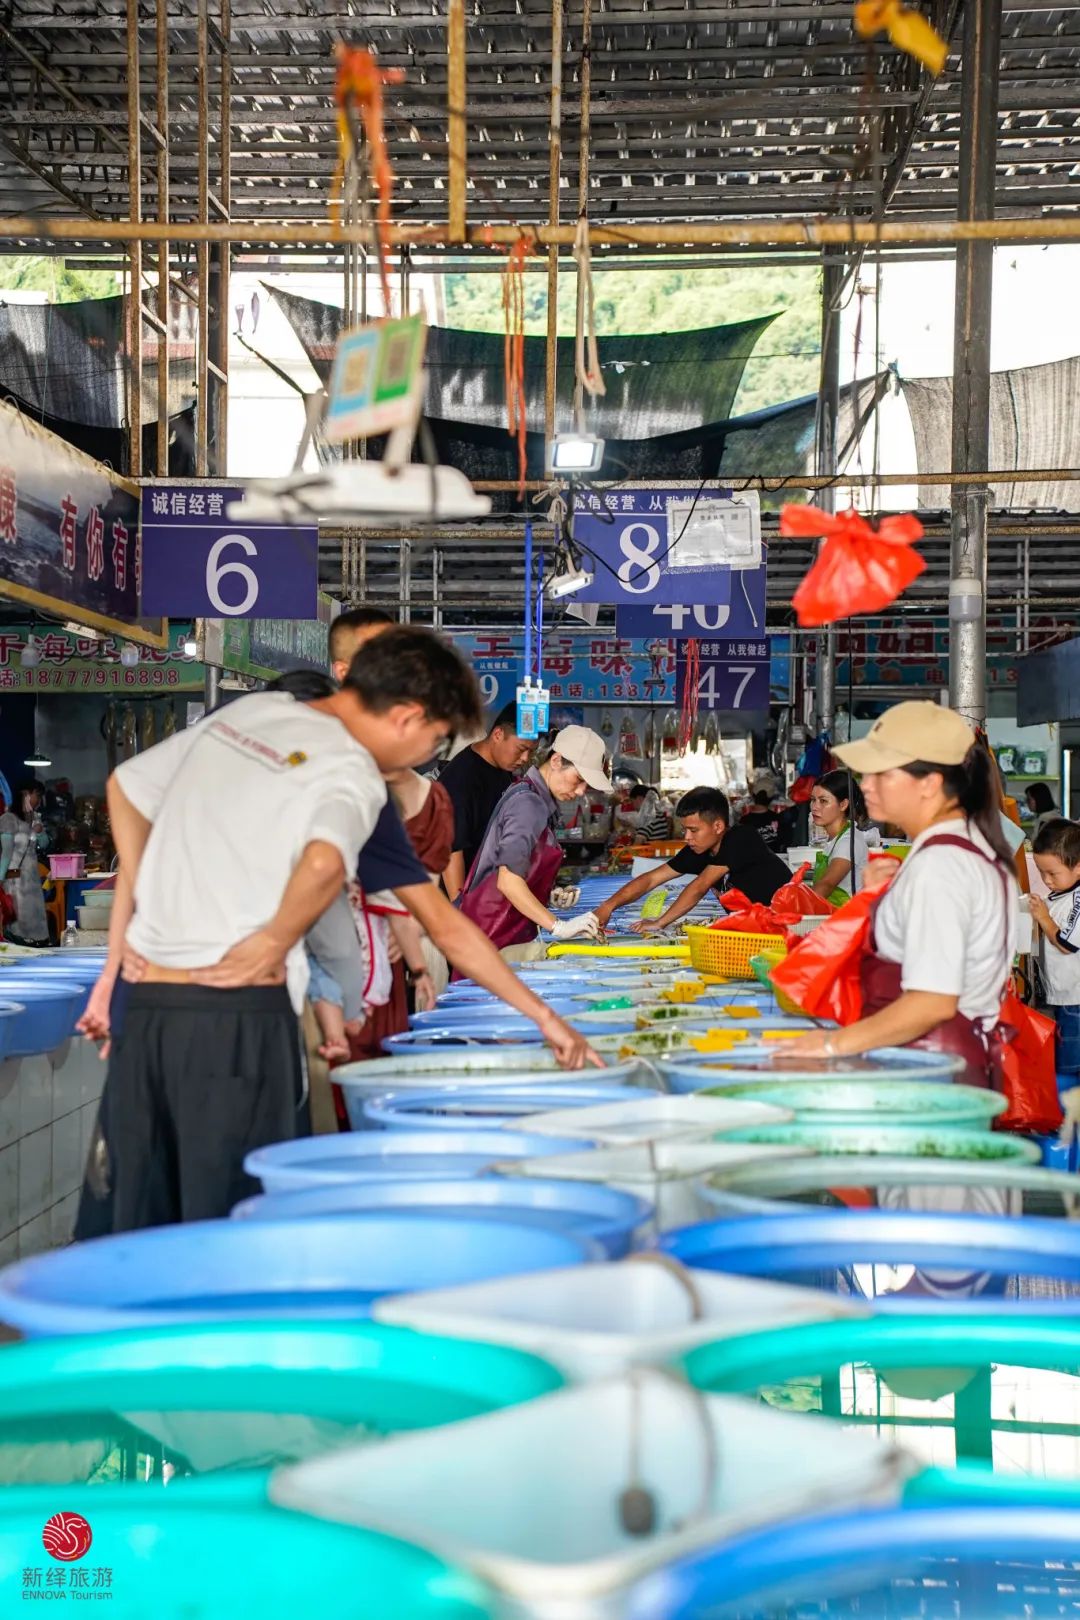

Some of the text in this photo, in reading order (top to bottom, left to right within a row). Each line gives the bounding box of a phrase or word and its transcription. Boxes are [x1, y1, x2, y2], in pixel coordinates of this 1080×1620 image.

[151, 492, 224, 516] 诚信经营
[206, 534, 259, 616] 6
[618, 523, 660, 594] 8
[692, 666, 756, 708] 47
